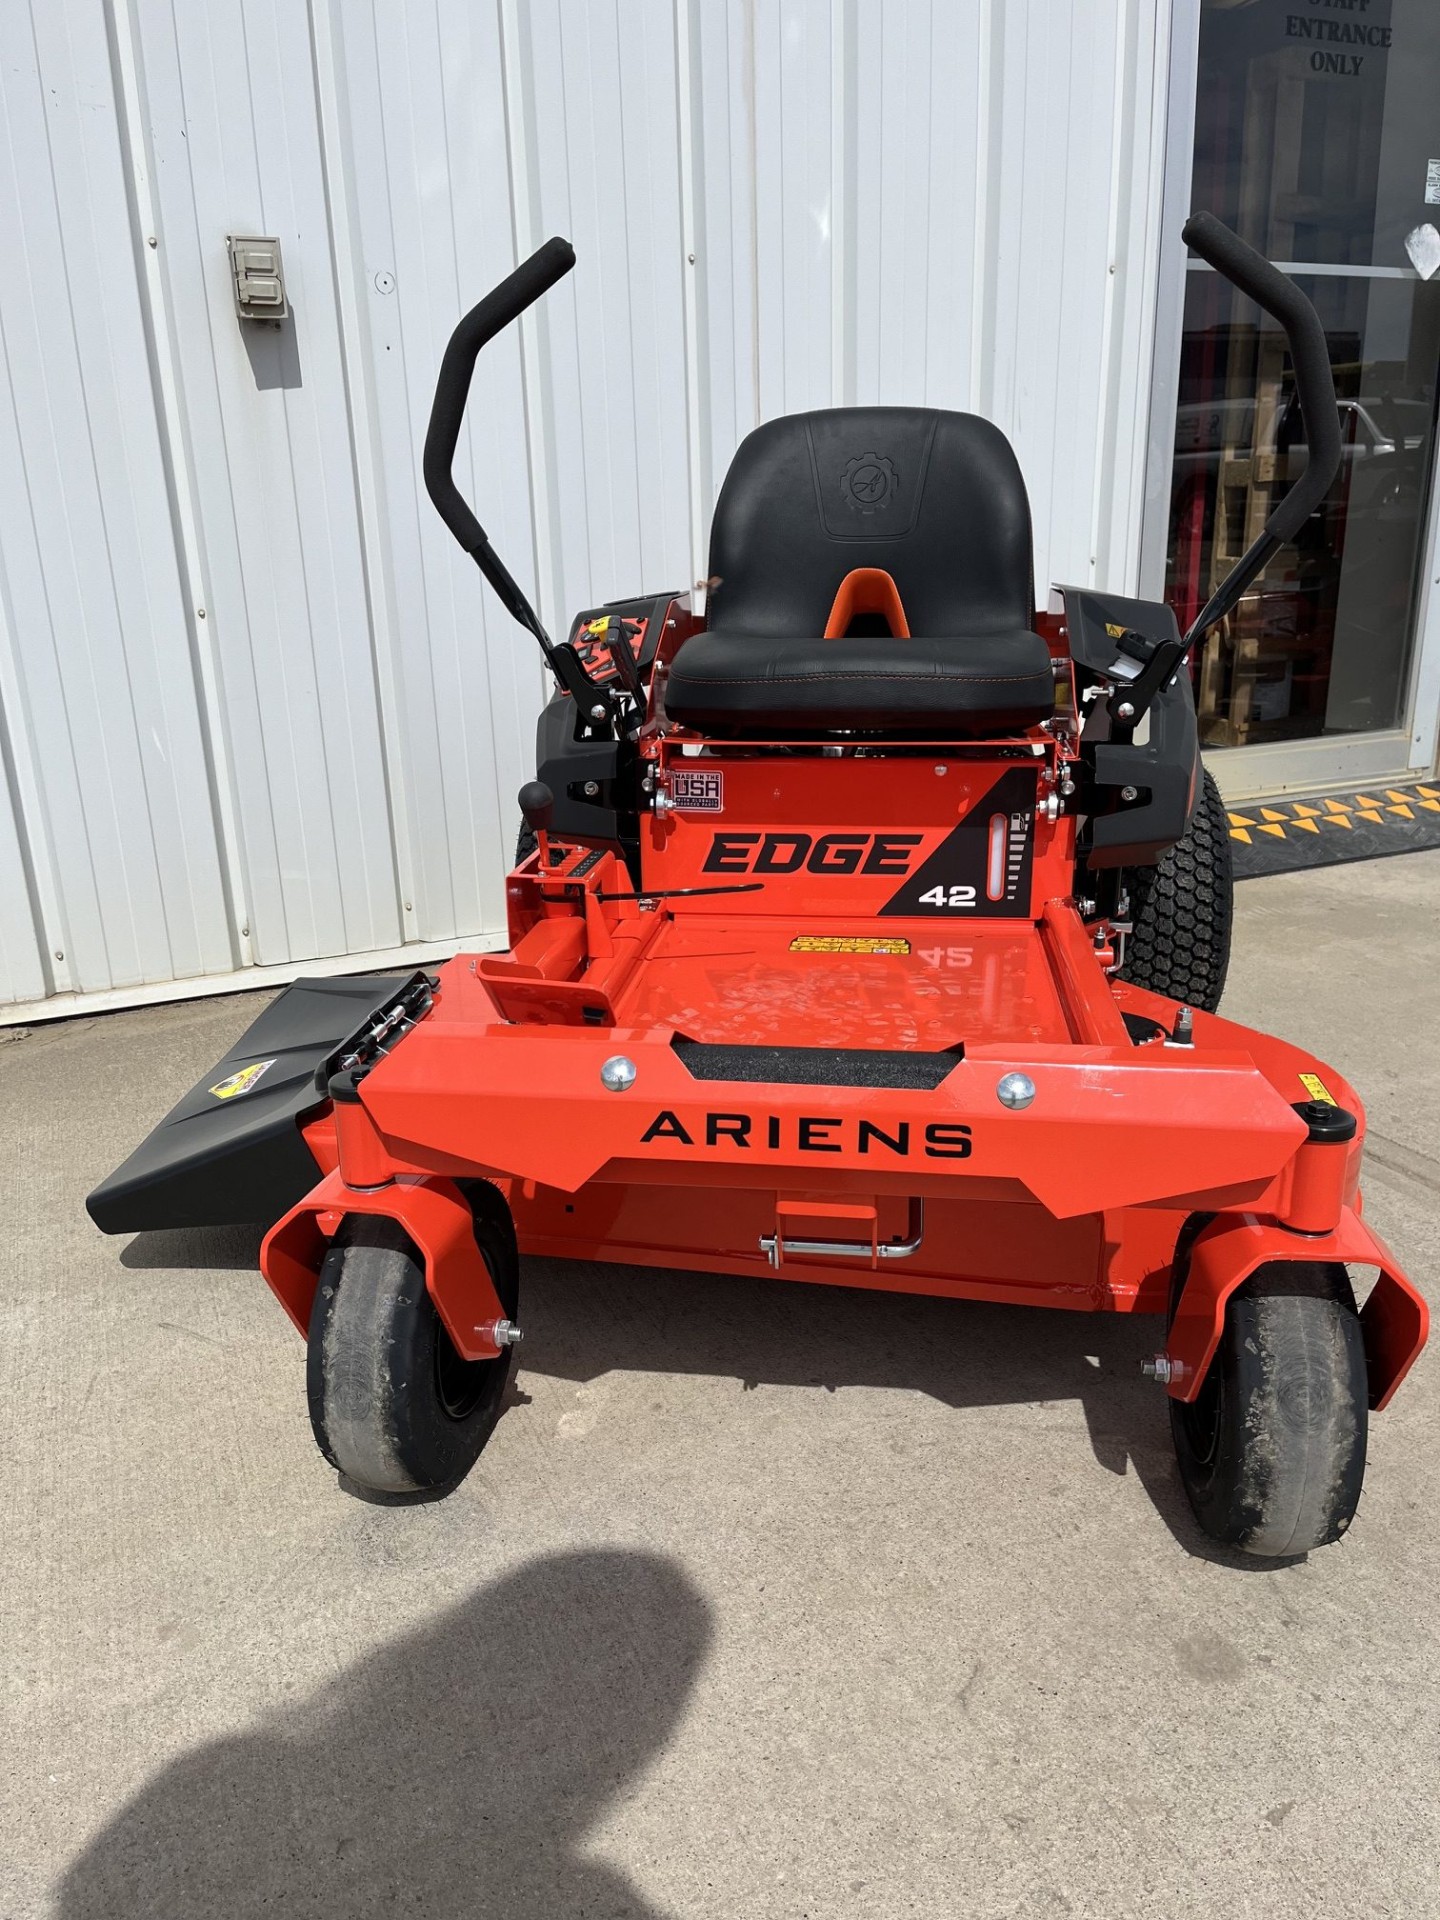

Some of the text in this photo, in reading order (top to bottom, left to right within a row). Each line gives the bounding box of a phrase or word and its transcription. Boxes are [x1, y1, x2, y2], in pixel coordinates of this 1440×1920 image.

[1285, 15, 1392, 47] ENTRANCE
[1310, 51, 1364, 76] ONLY
[675, 780, 719, 797] USA
[702, 832, 925, 875] EDGE
[918, 885, 977, 907] 42
[639, 1110, 973, 1159] ARIENS
